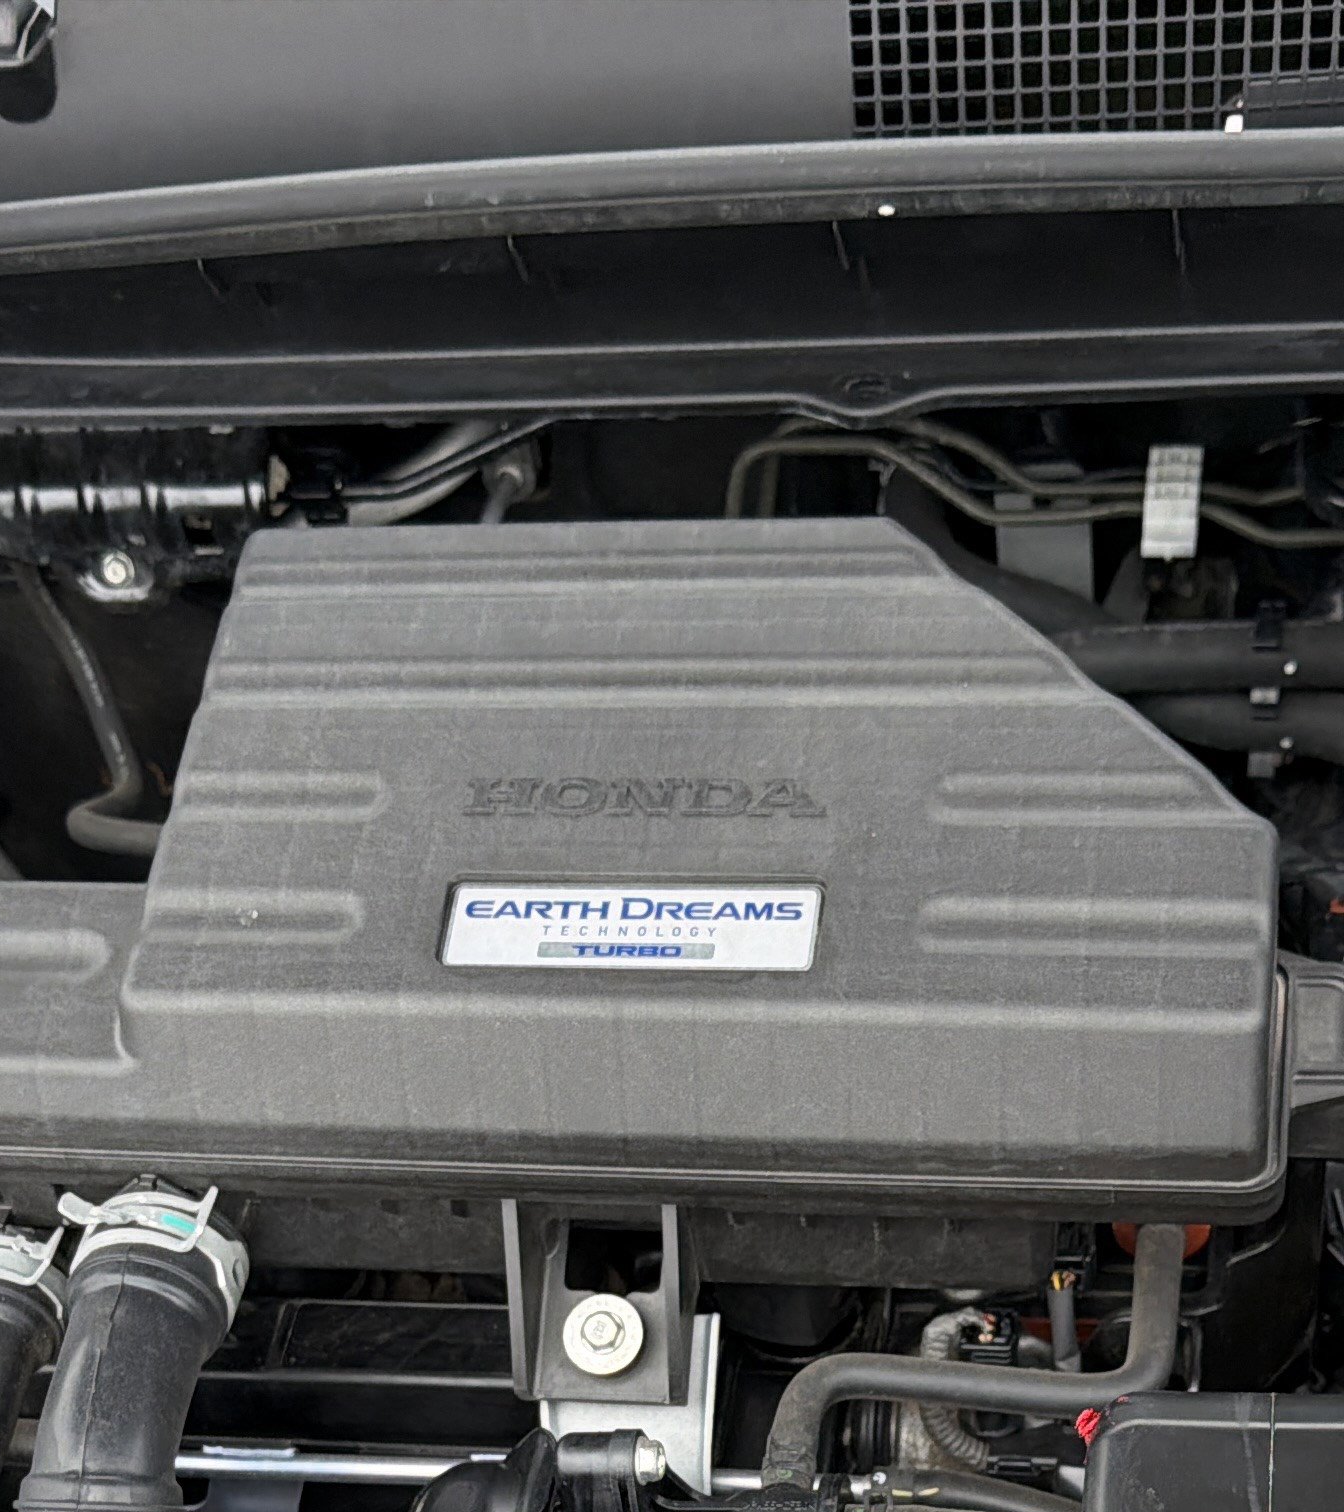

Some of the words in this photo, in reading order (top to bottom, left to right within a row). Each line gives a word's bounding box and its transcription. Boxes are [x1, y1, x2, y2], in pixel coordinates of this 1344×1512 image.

[461, 777, 828, 819] HONDA
[465, 899, 612, 921] EARTH
[619, 897, 804, 922] DREAMS
[541, 925, 719, 938] TECHNOLOGY
[572, 944, 683, 959] TURBO
